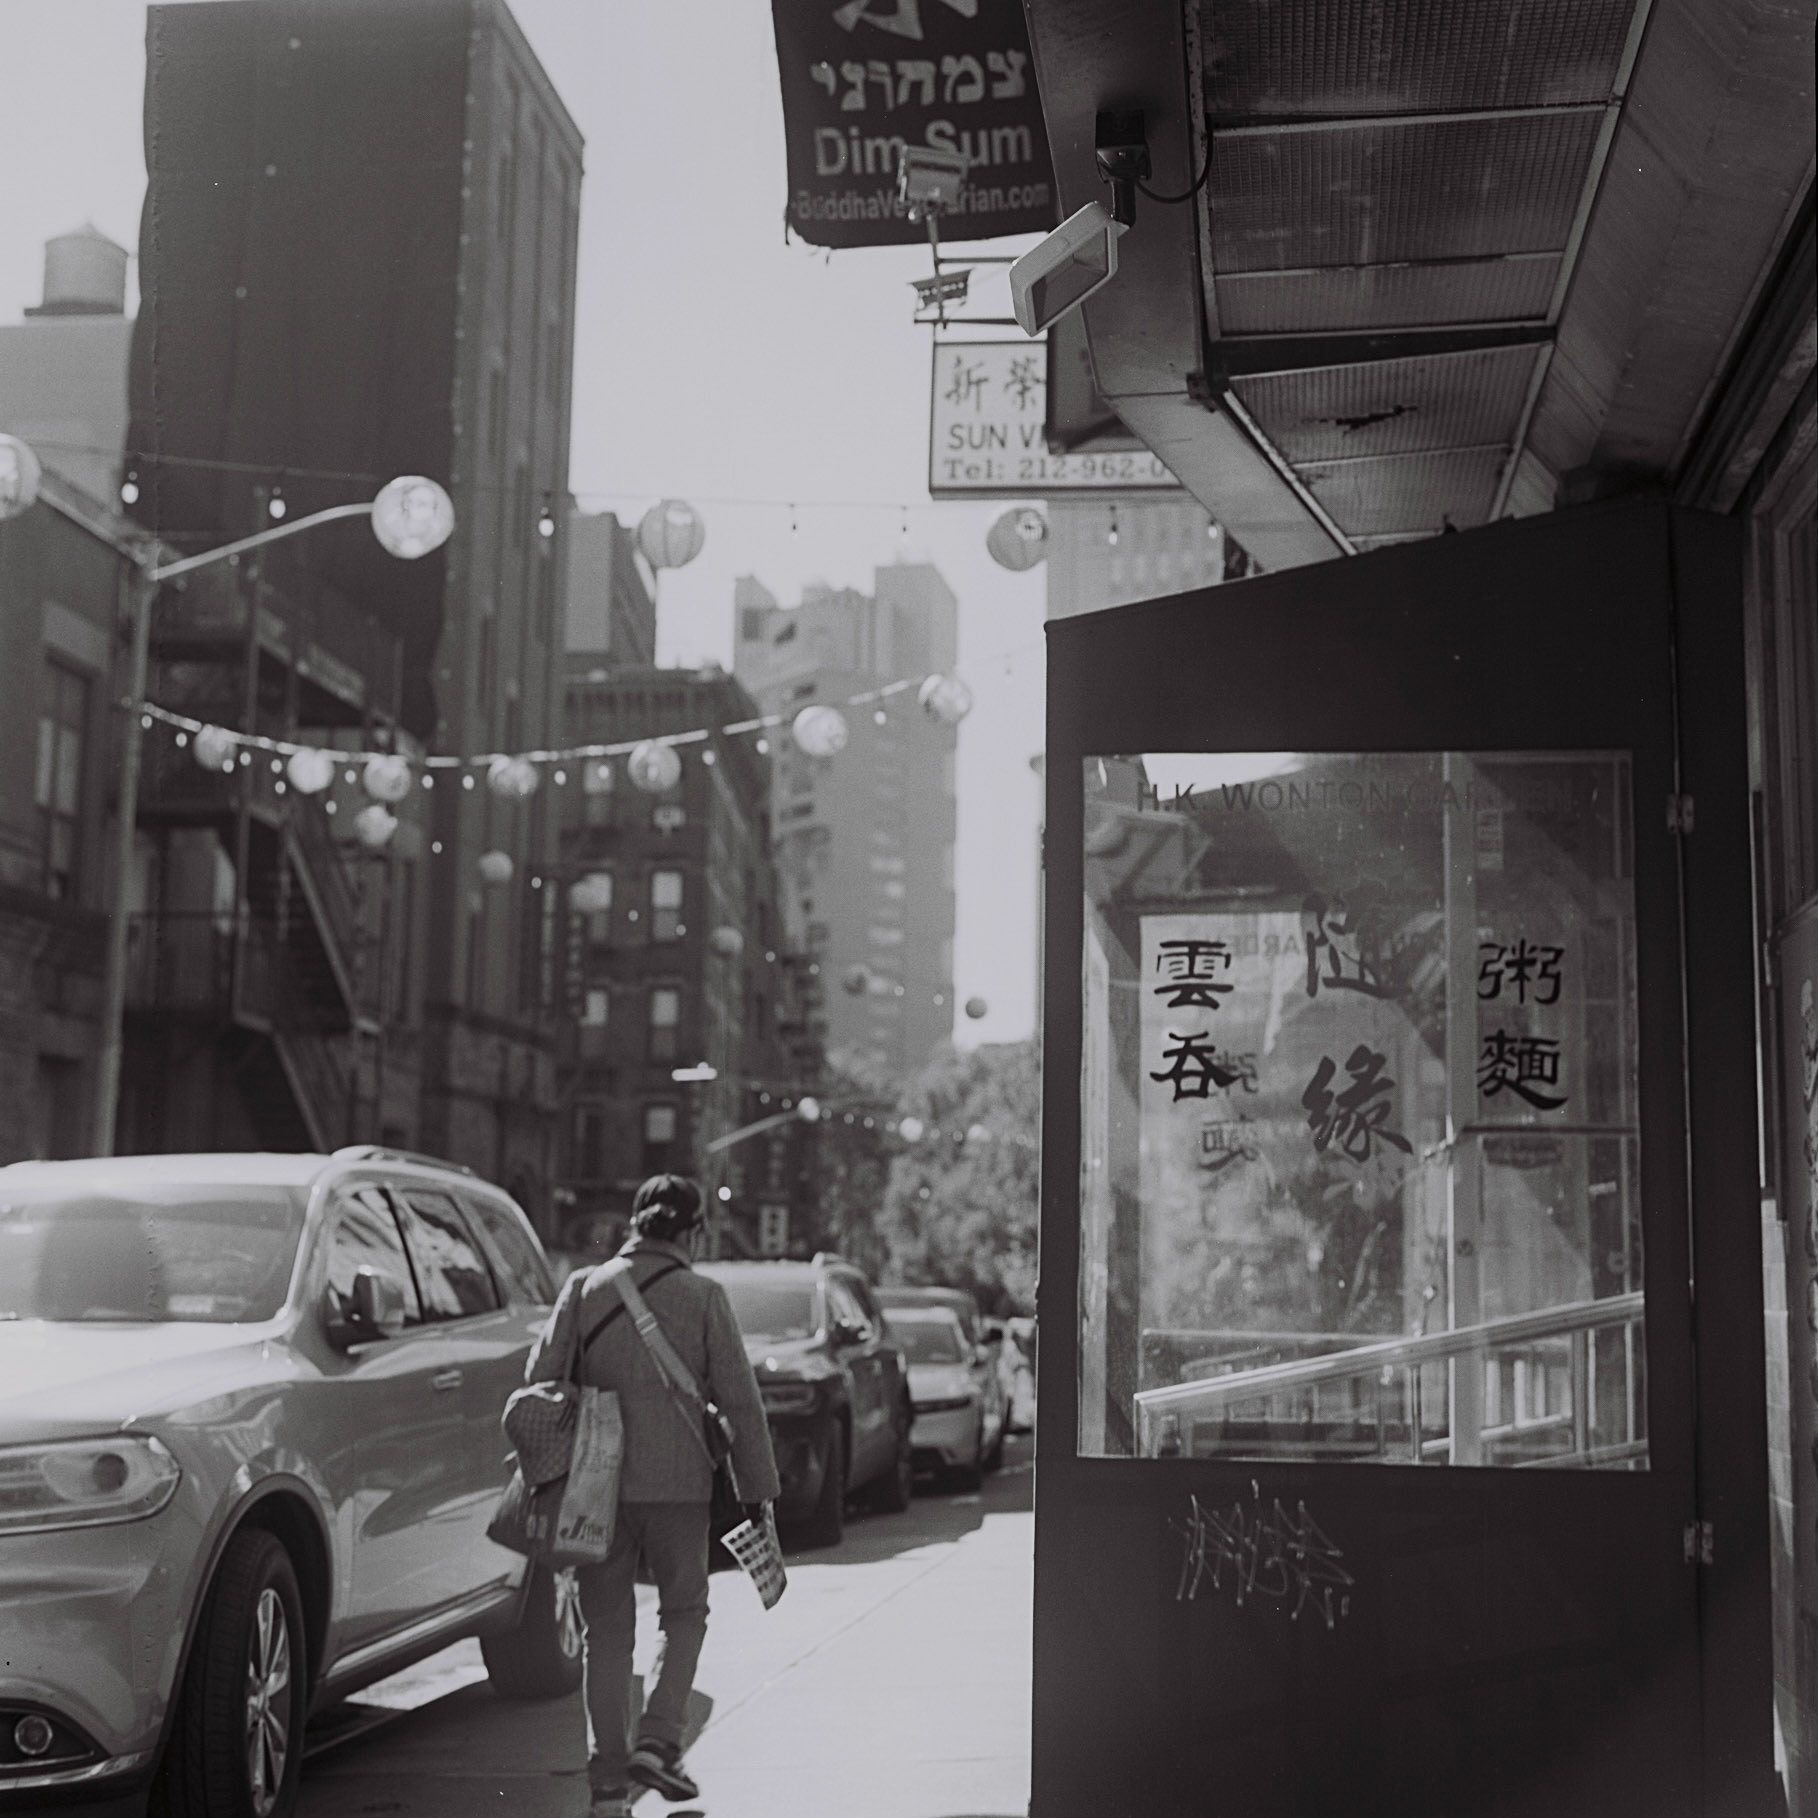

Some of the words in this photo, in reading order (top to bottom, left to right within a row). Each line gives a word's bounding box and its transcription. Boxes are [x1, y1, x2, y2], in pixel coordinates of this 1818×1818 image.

[813, 125, 907, 177] Dim
[924, 119, 1033, 169] Sum
[948, 423, 1008, 450] SUN
[1019, 423, 1044, 449] V
[943, 457, 1005, 480] Tel:
[1019, 456, 1167, 480] 212-962-0
[1220, 780, 1391, 811] WONTON
[1149, 938, 1241, 1104] 雲吞
[1475, 937, 1569, 1111] 粥麵
